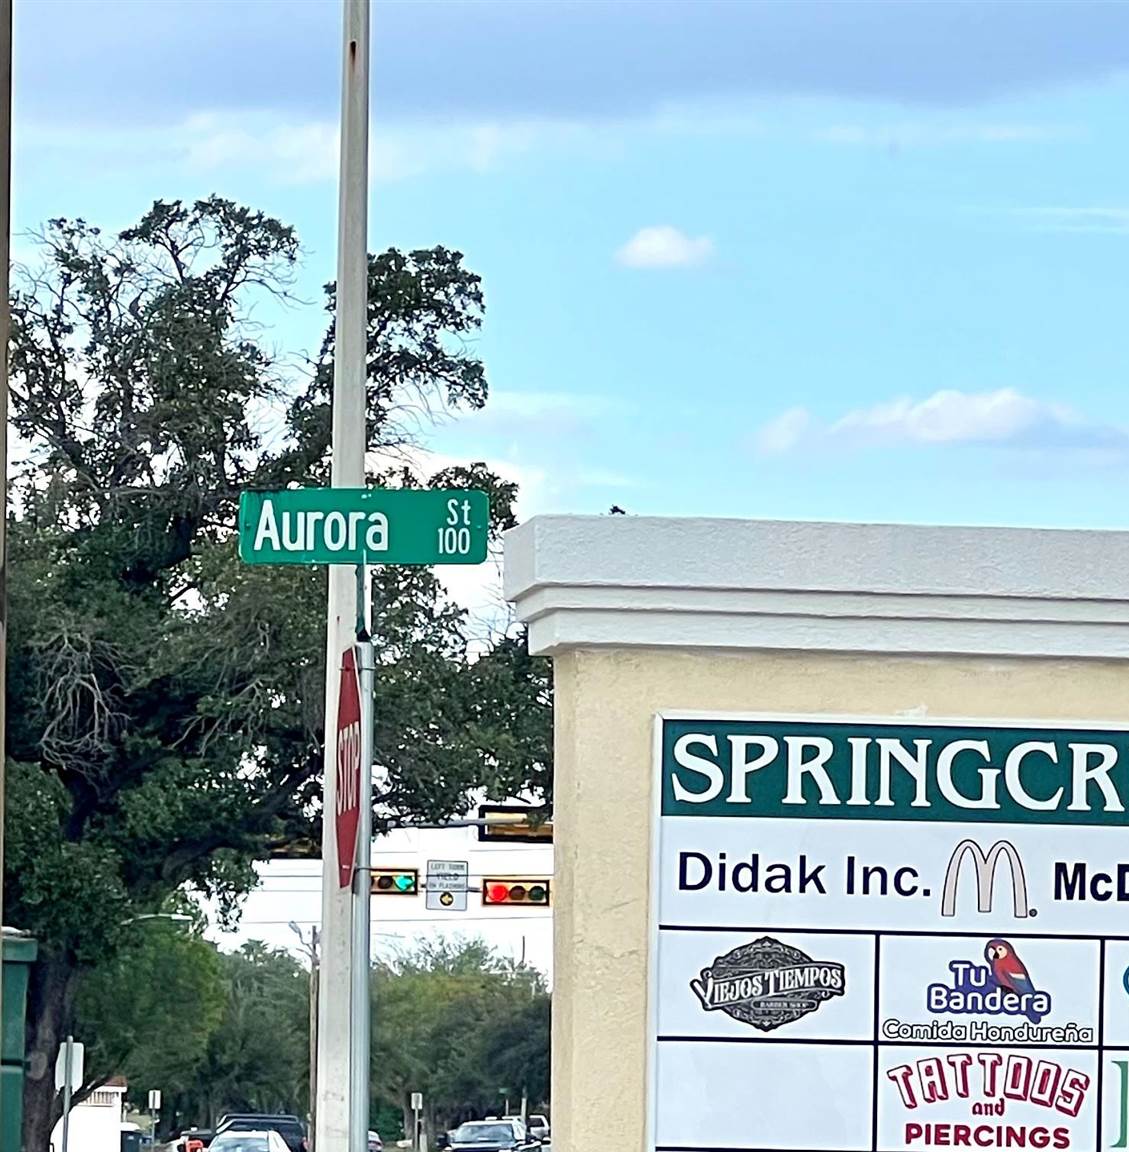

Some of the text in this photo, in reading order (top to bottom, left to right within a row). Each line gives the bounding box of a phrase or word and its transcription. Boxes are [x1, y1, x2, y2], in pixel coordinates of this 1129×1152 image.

[253, 499, 389, 552] Aurora
[446, 498, 472, 526] St
[437, 527, 471, 555] 100
[336, 720, 360, 817] STOP
[678, 851, 931, 897] Didak Inc.
[692, 965, 844, 1009] VIEJOS TIEMPOS
[951, 963, 987, 987] Tu
[929, 986, 1049, 1013] Bandera
[883, 1018, 1094, 1043] Comida Hondureña
[887, 1053, 1091, 1118] TATTOOS
[971, 1097, 1006, 1117] and
[904, 1122, 1071, 1150] PIERCINGS
